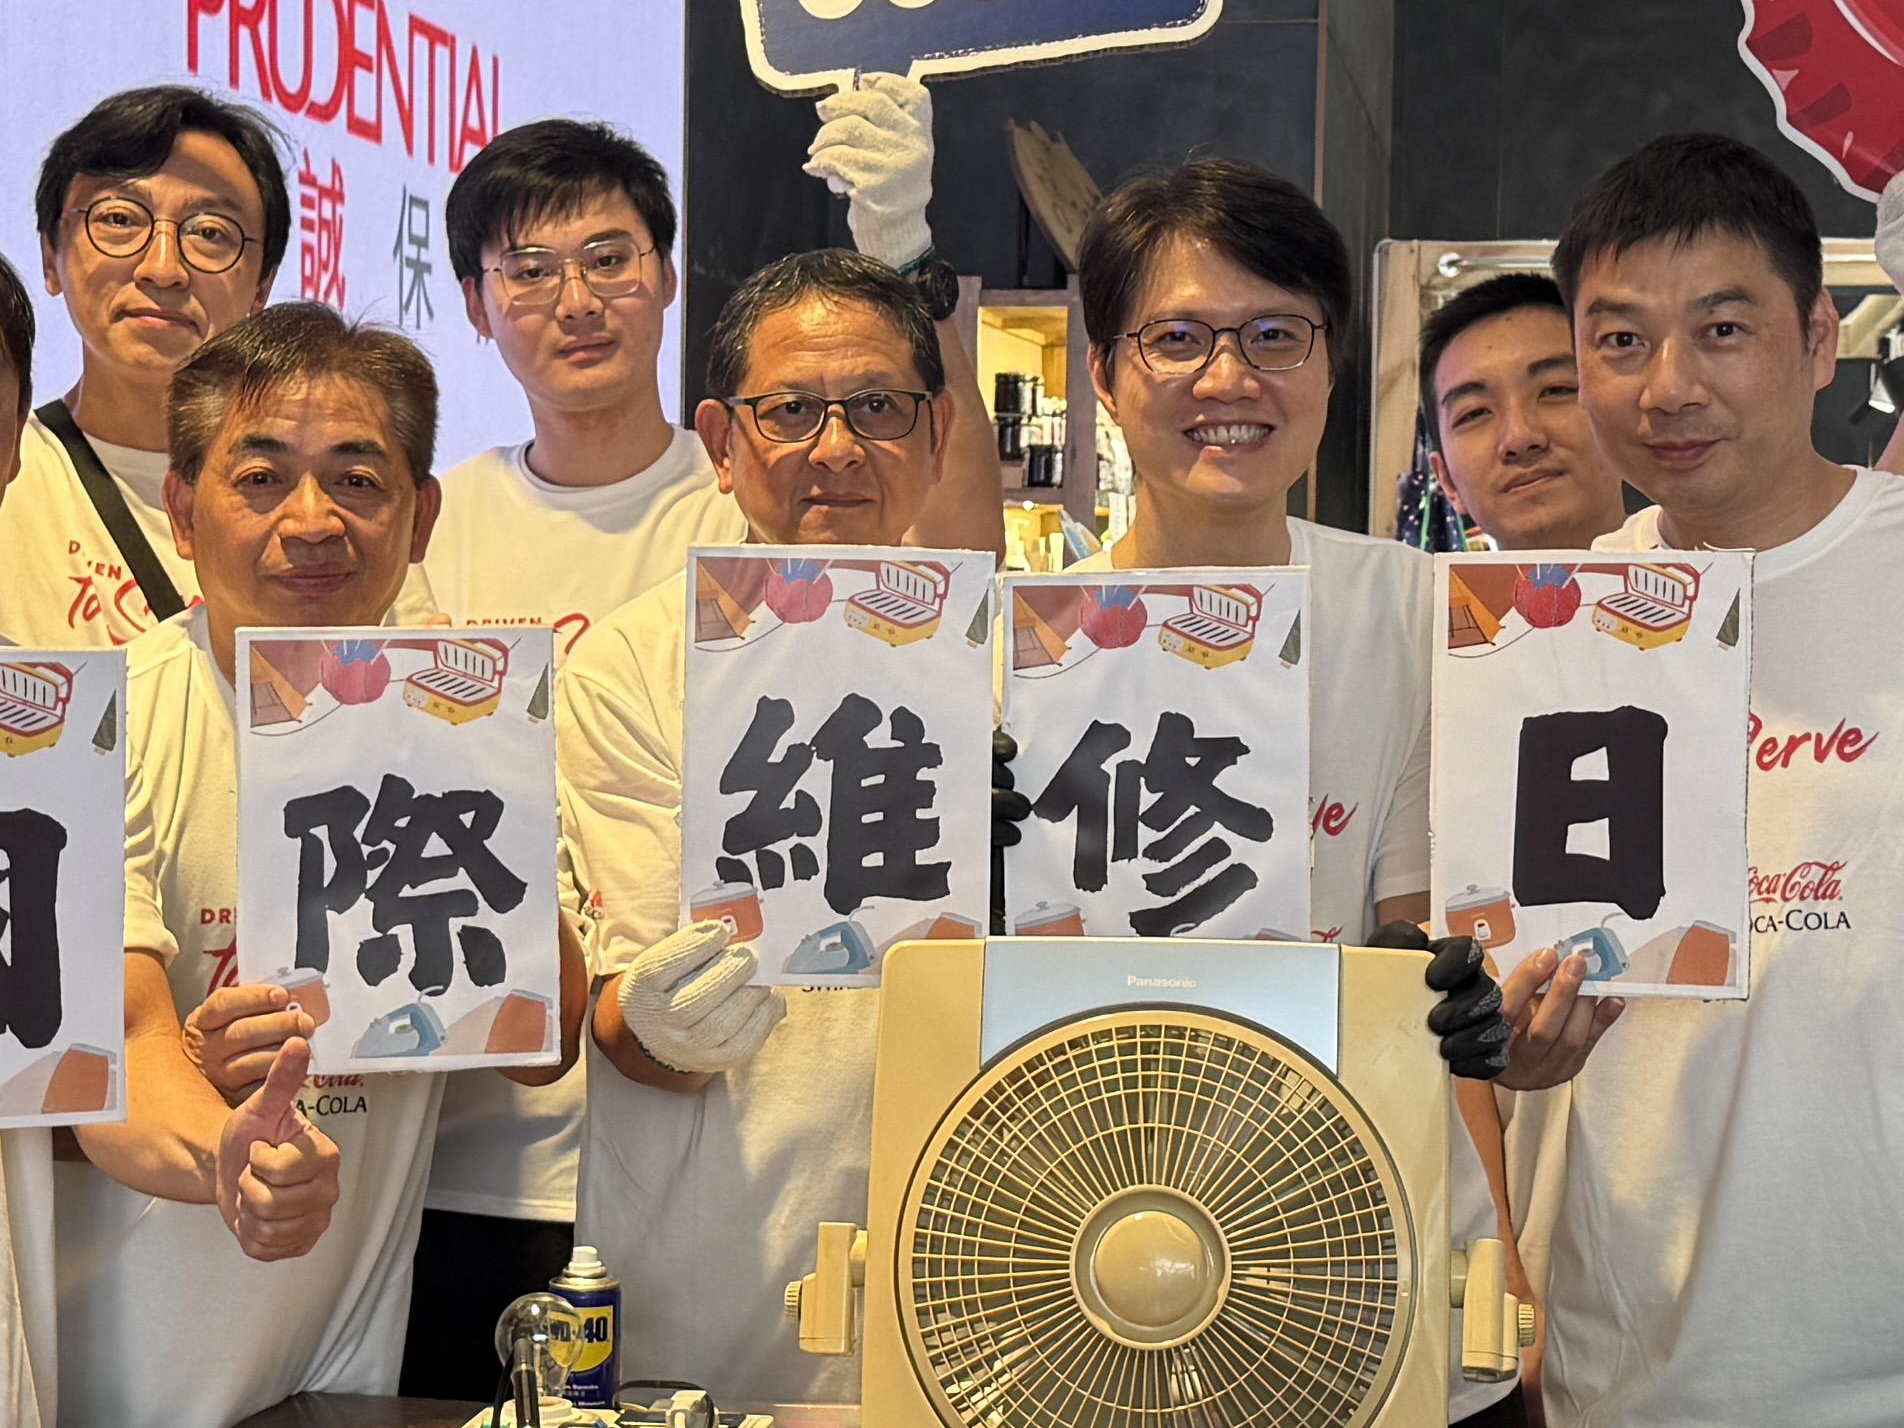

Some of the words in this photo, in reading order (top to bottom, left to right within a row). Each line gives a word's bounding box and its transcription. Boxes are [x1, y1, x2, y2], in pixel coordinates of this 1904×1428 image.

[283, 773, 528, 996] 際
[715, 692, 953, 916] 維
[1030, 710, 1275, 938] 修
[1512, 705, 1669, 921] 日
[1126, 974, 1198, 989] Panasonic
[1749, 909, 1852, 934] CA-COLA
[295, 1093, 368, 1118] A-COLA
